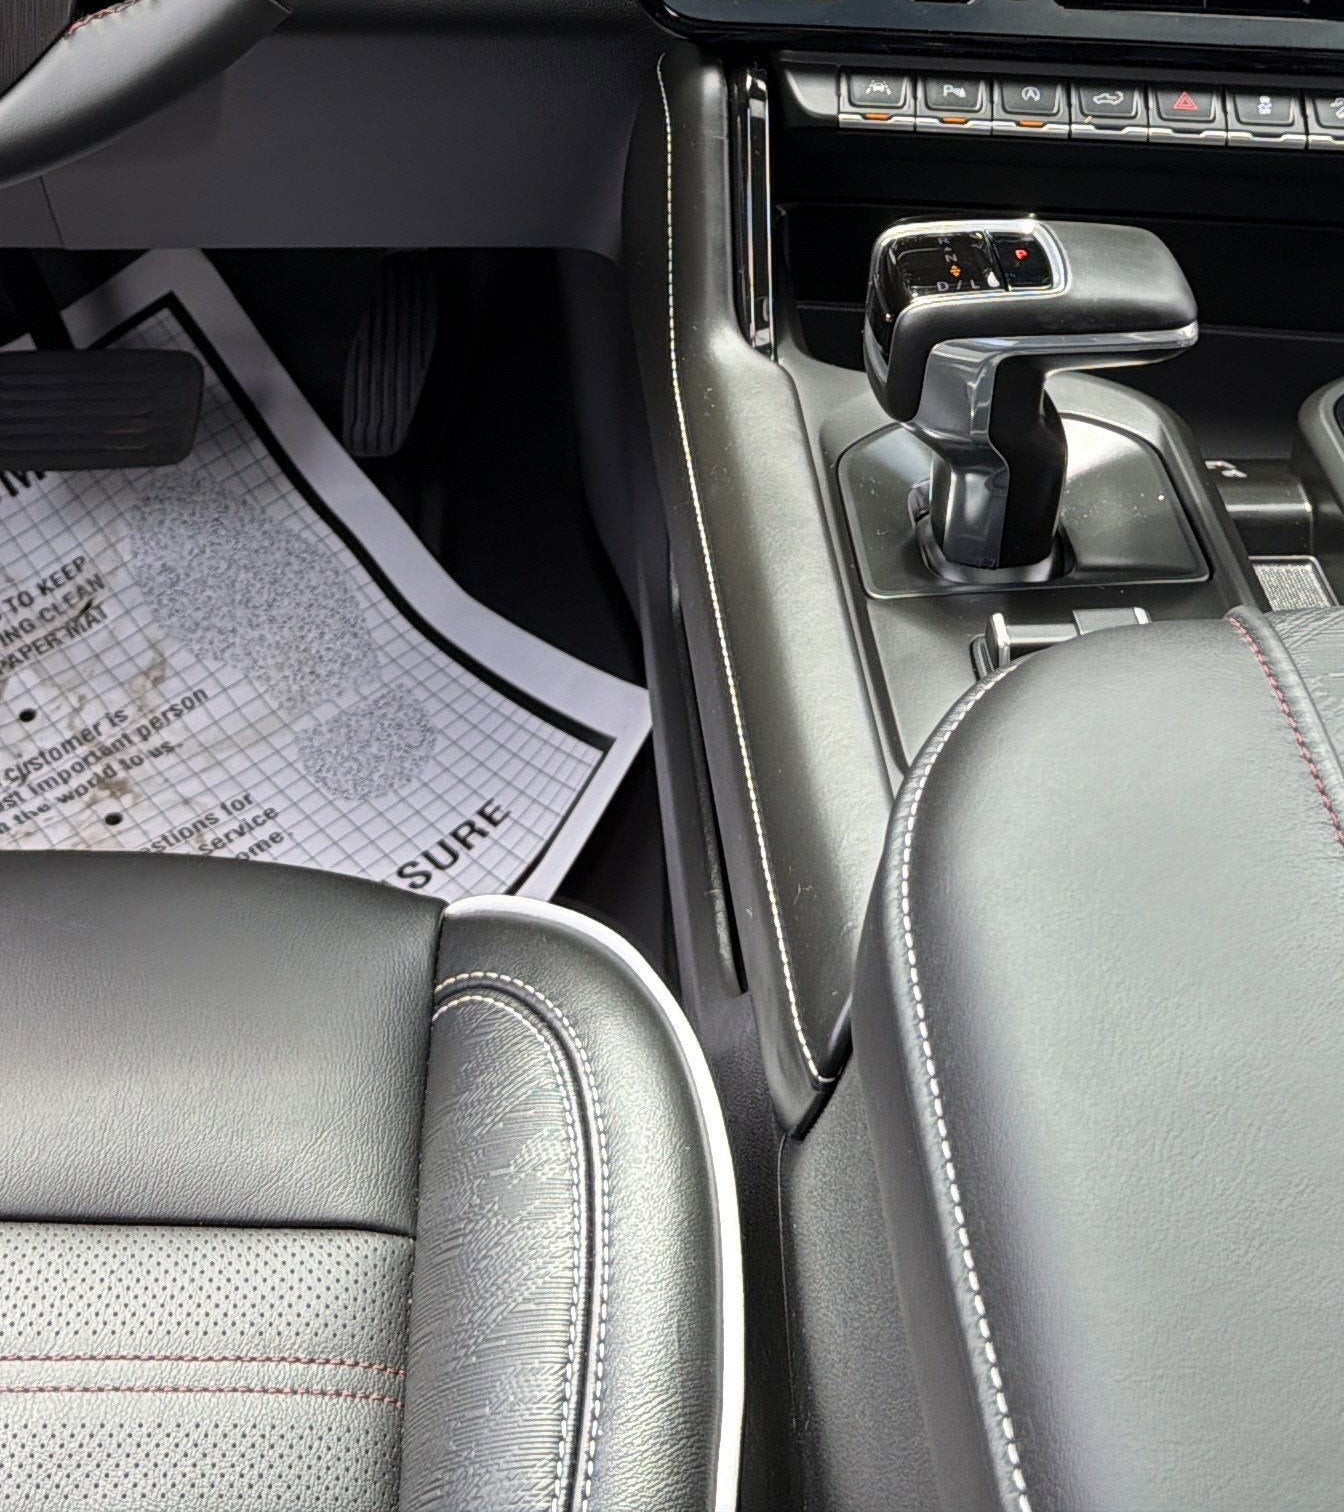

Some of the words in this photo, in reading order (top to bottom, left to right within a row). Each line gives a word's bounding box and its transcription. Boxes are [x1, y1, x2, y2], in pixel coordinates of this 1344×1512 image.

[2, 589, 36, 616] TO
[35, 554, 88, 596] KEEP
[38, 572, 107, 624] CLEAN
[60, 601, 109, 640] MAT
[4, 722, 105, 785] customer
[107, 707, 130, 729] is
[28, 731, 136, 797] important
[133, 687, 210, 743] person
[12, 802, 52, 825] the
[56, 764, 118, 806] world
[118, 753, 146, 773] to
[220, 790, 256, 817] for
[198, 804, 280, 856] service
[395, 796, 512, 891] SURE
